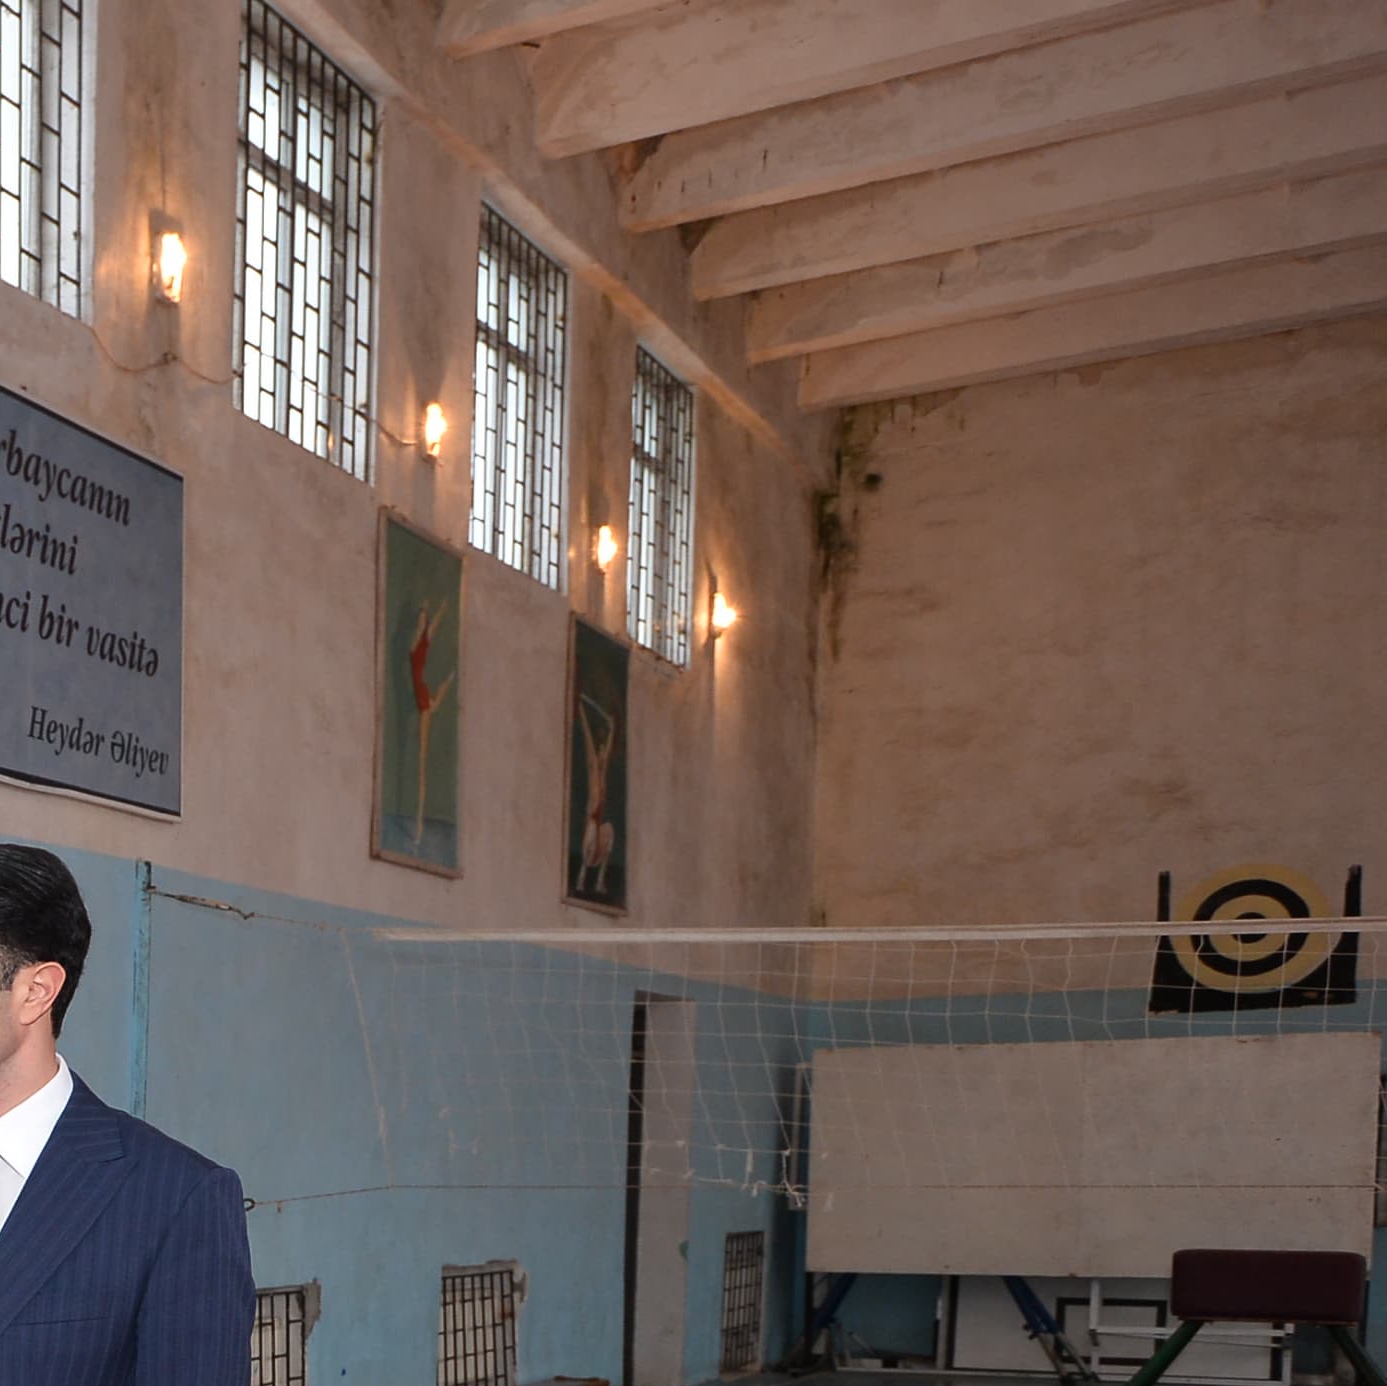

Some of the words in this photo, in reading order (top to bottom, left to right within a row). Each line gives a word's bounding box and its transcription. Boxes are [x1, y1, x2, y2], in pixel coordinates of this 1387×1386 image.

[39, 595, 79, 647] bir
[87, 627, 159, 676] vasitə
[27, 706, 105, 757] Heydər
[111, 731, 169, 776] Əliyev
